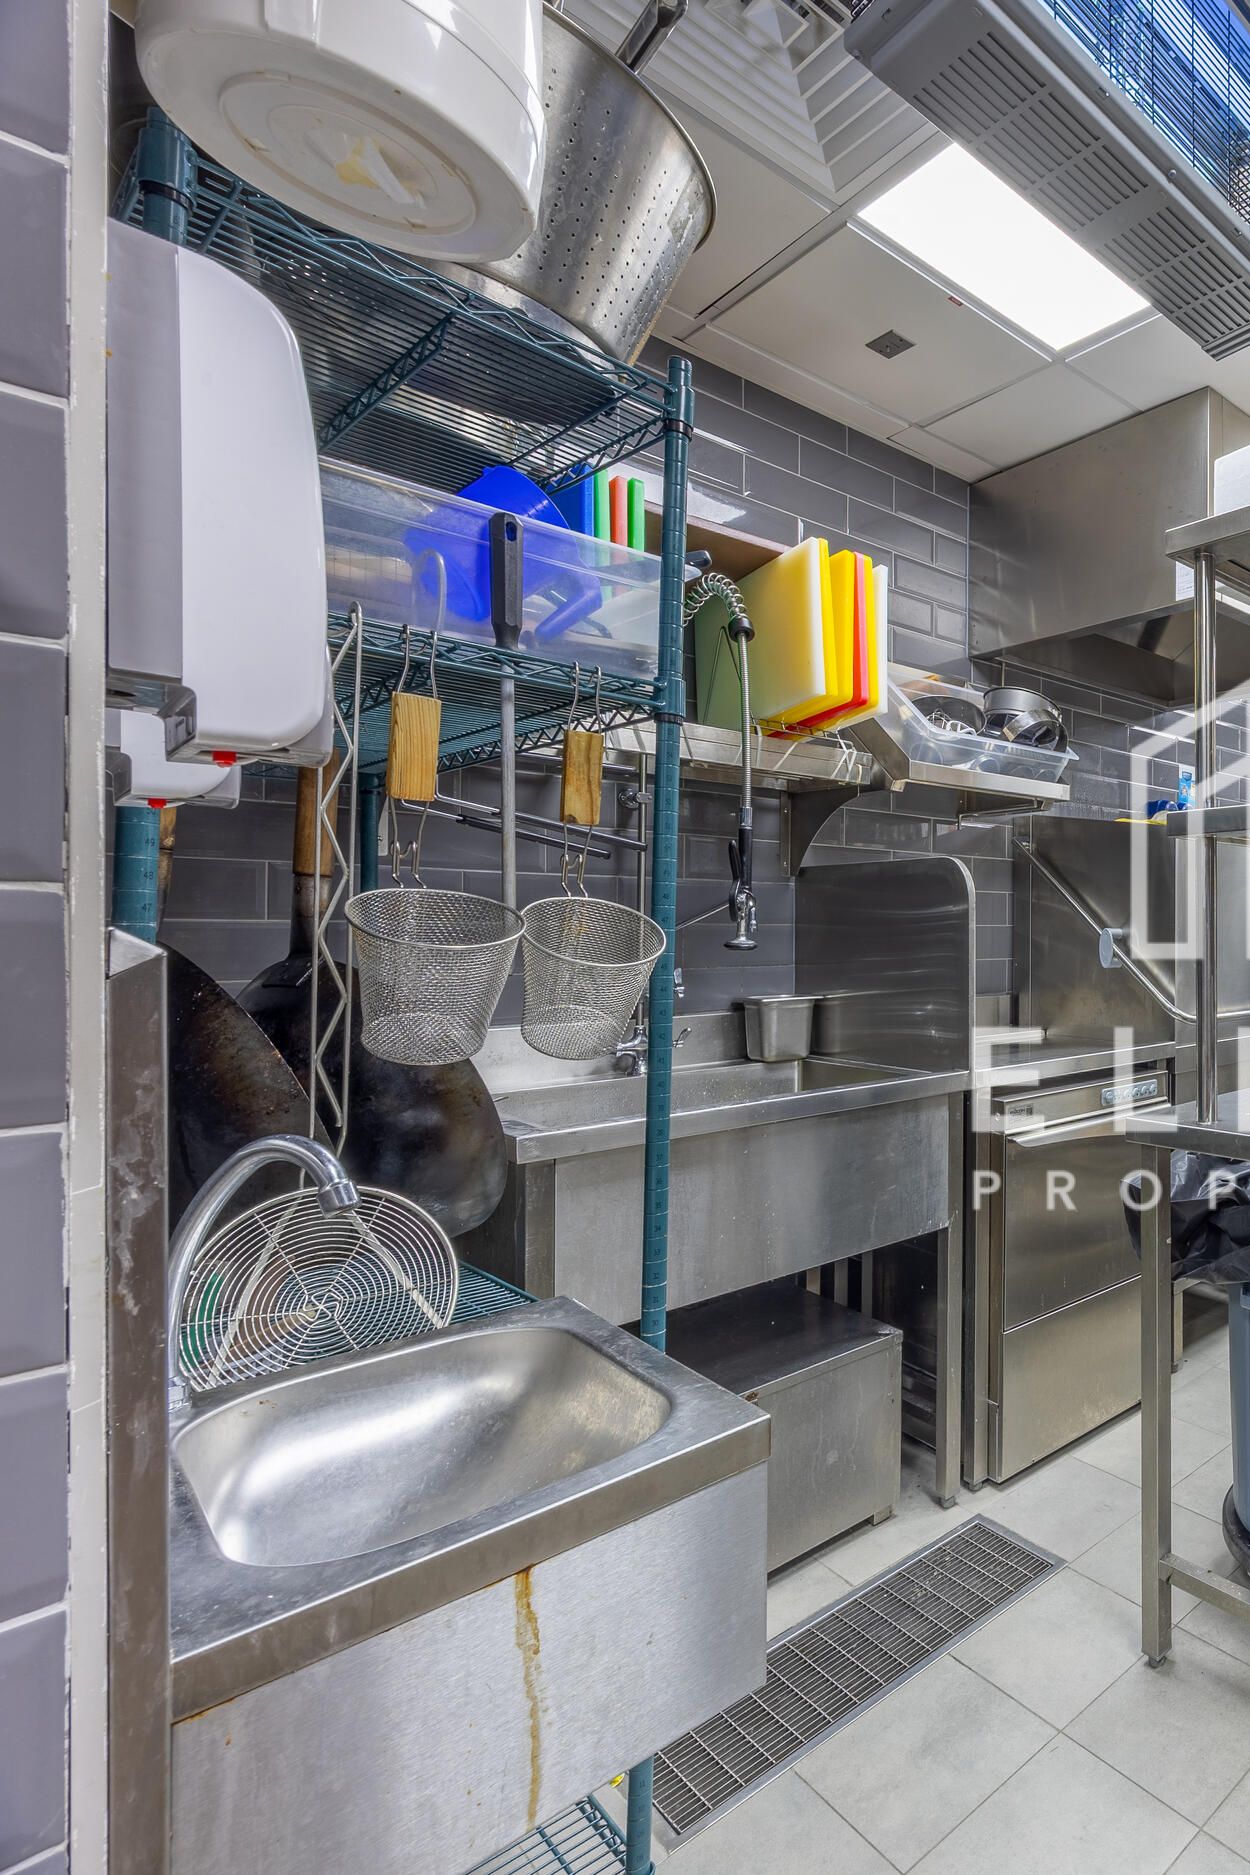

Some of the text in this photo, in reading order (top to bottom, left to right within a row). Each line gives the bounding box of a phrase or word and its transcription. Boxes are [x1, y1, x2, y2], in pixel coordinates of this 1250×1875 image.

[144, 837, 155, 847] 49
[143, 871, 154, 880] 48
[141, 903, 153, 913] 47
